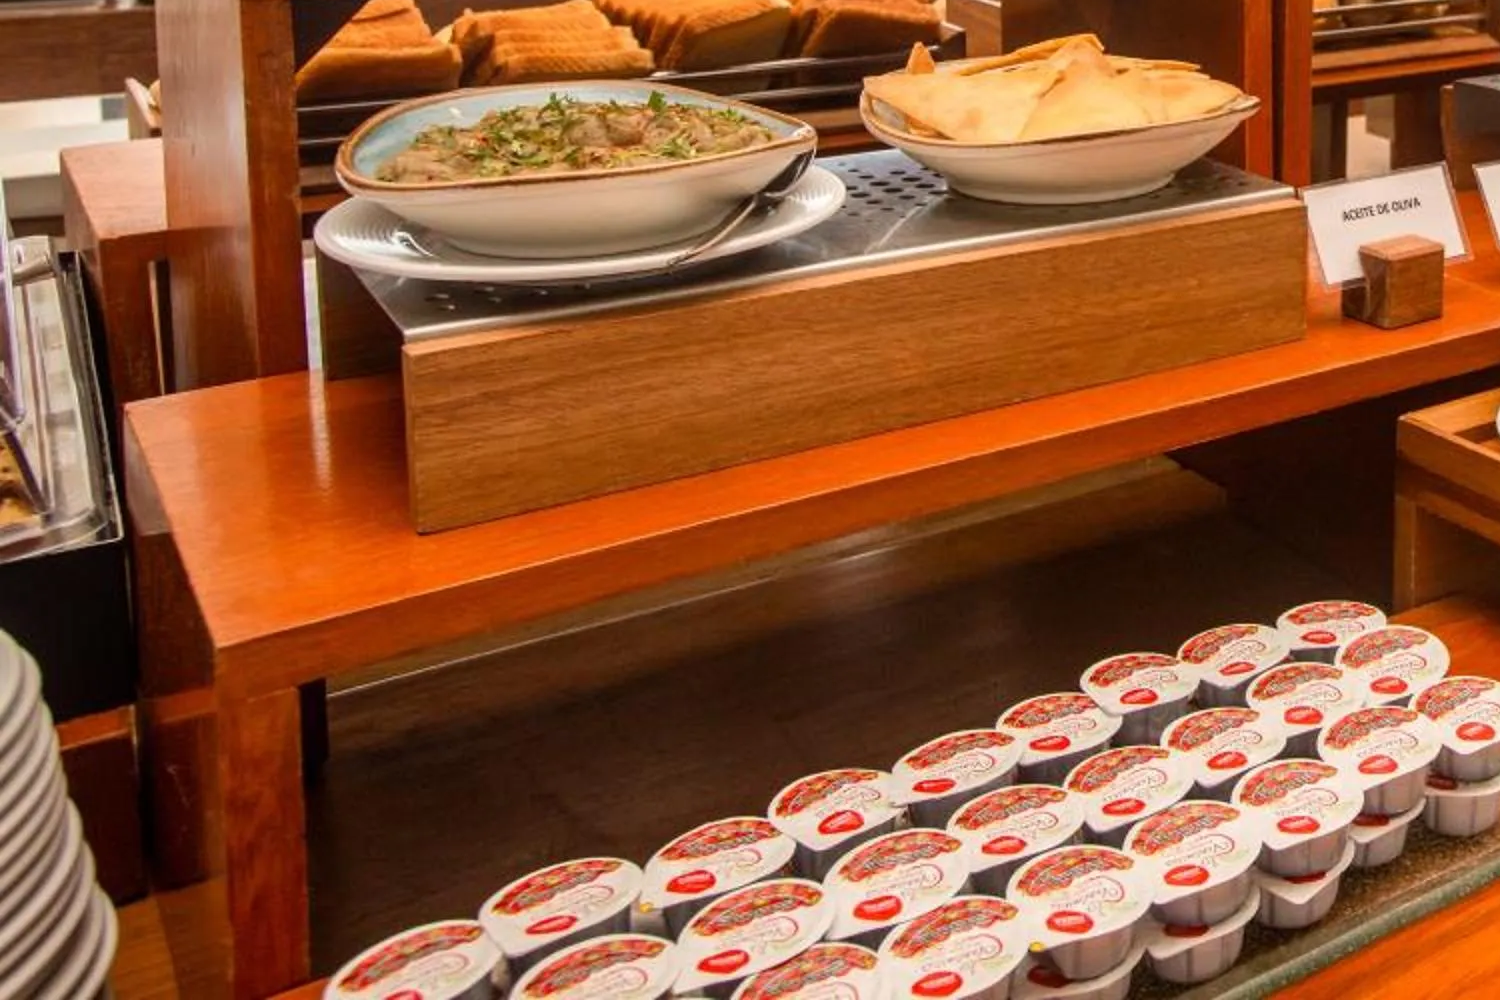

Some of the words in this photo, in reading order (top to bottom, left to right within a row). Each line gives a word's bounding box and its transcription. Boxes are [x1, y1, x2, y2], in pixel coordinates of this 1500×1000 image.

[1343, 205, 1375, 222] ACEITE
[1376, 201, 1390, 214] DE
[1391, 196, 1422, 212] OLIVA
